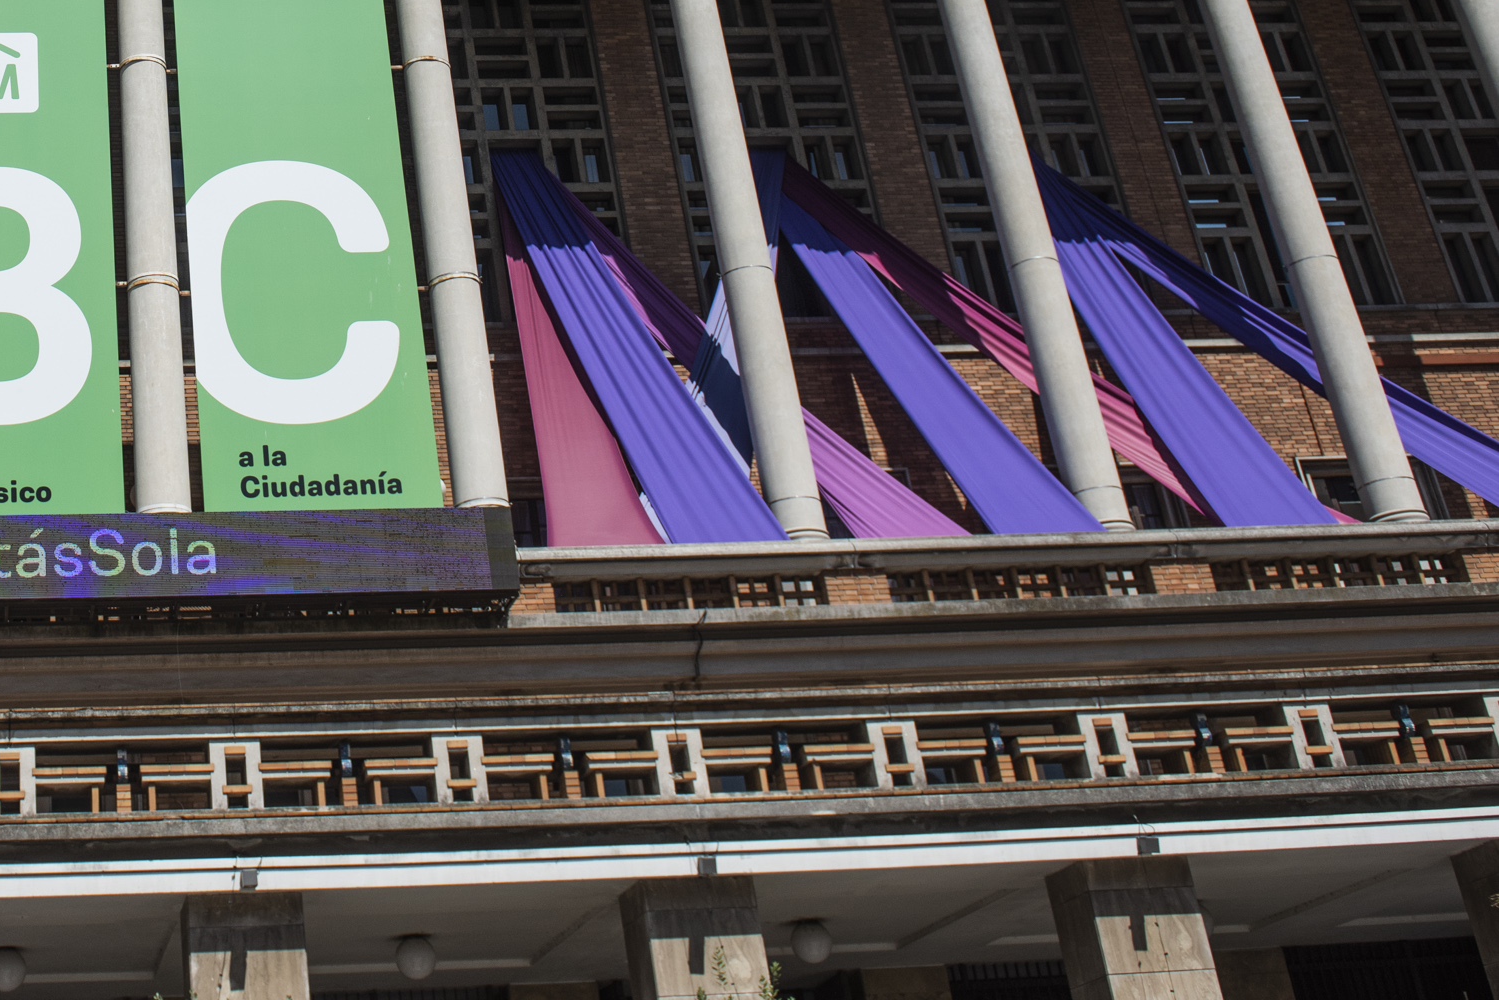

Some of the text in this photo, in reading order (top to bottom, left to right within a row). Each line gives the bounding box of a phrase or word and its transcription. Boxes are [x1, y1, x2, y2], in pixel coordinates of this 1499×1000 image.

[185, 159, 401, 425] C
[238, 444, 287, 468] a la
[240, 470, 403, 499] Ciudadanía
